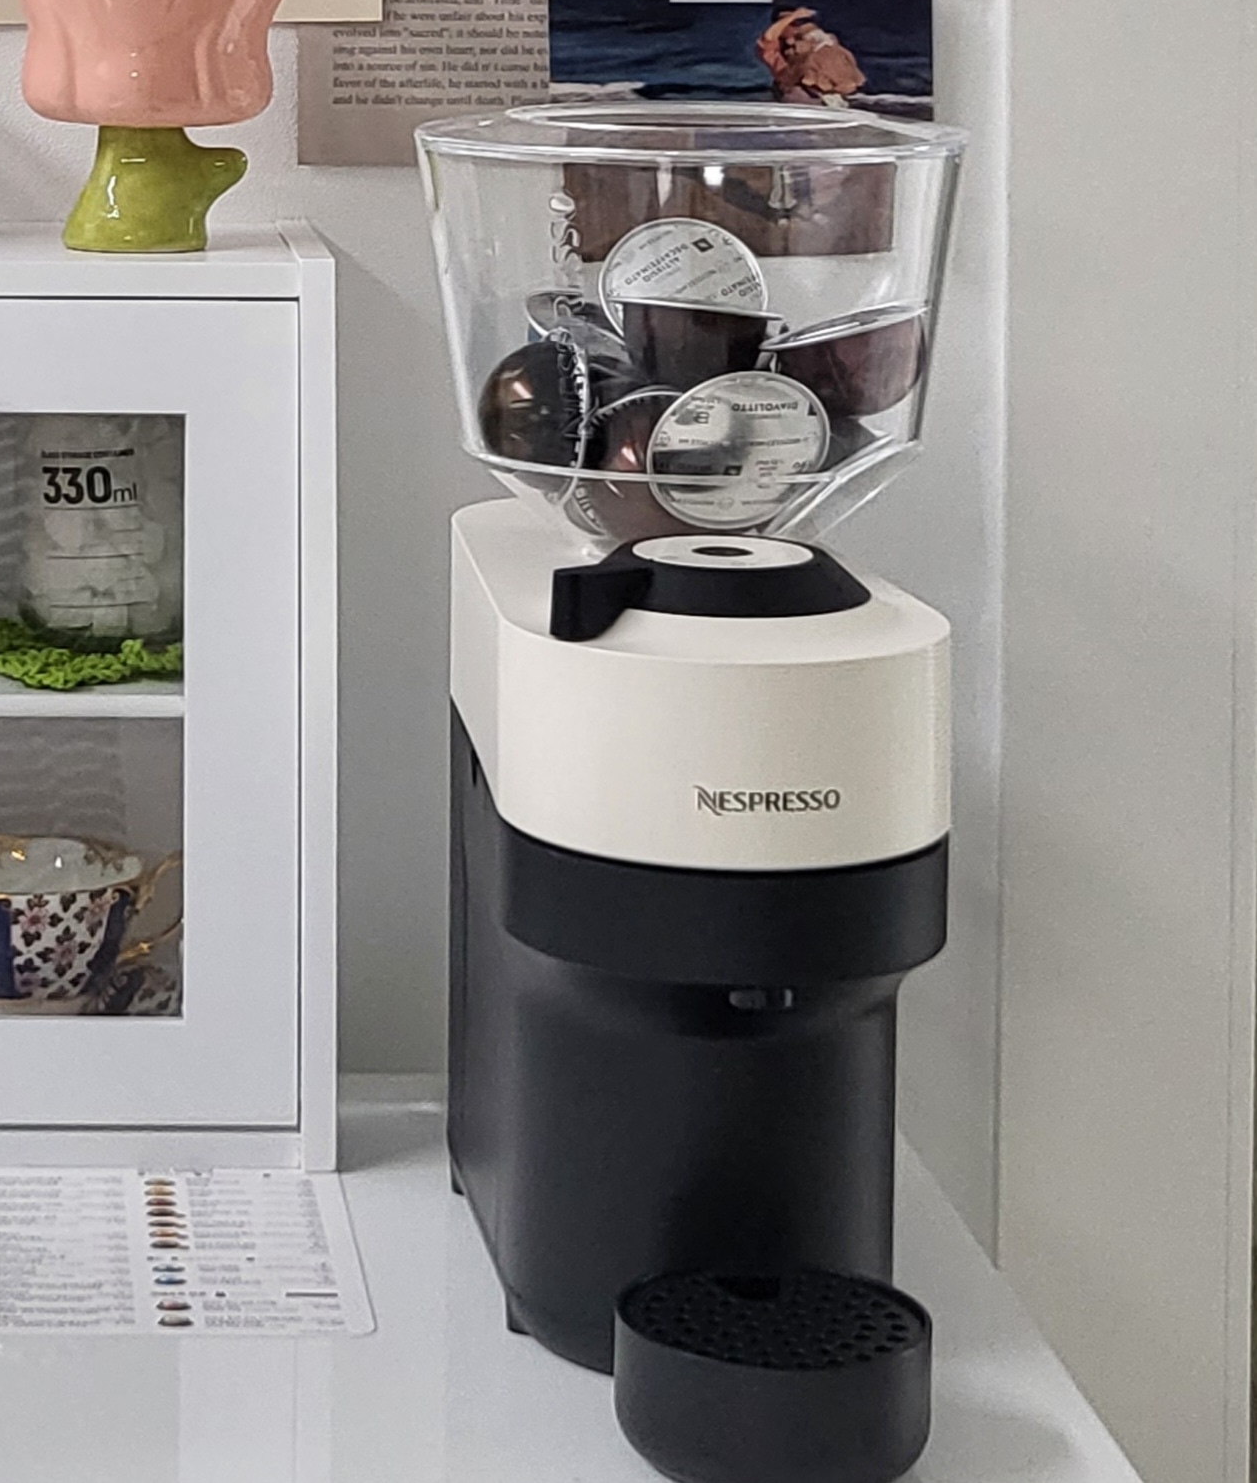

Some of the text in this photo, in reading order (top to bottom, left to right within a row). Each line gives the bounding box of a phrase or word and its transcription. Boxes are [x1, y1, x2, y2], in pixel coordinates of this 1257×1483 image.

[411, 10, 525, 21] were about his
[333, 27, 521, 38] evolved should be
[400, 44, 519, 55] his own nor did
[333, 61, 355, 72] into
[405, 61, 417, 72] of
[461, 61, 479, 72] did
[333, 78, 362, 89] favor
[364, 78, 377, 89] of
[379, 78, 396, 89] the
[448, 78, 462, 89] he
[504, 78, 528, 89] with
[333, 95, 472, 108] and he didn't change until
[731, 400, 799, 413] DIAVOLITTO
[42, 465, 138, 504] 330ml
[693, 785, 841, 816] NESPRESSO
